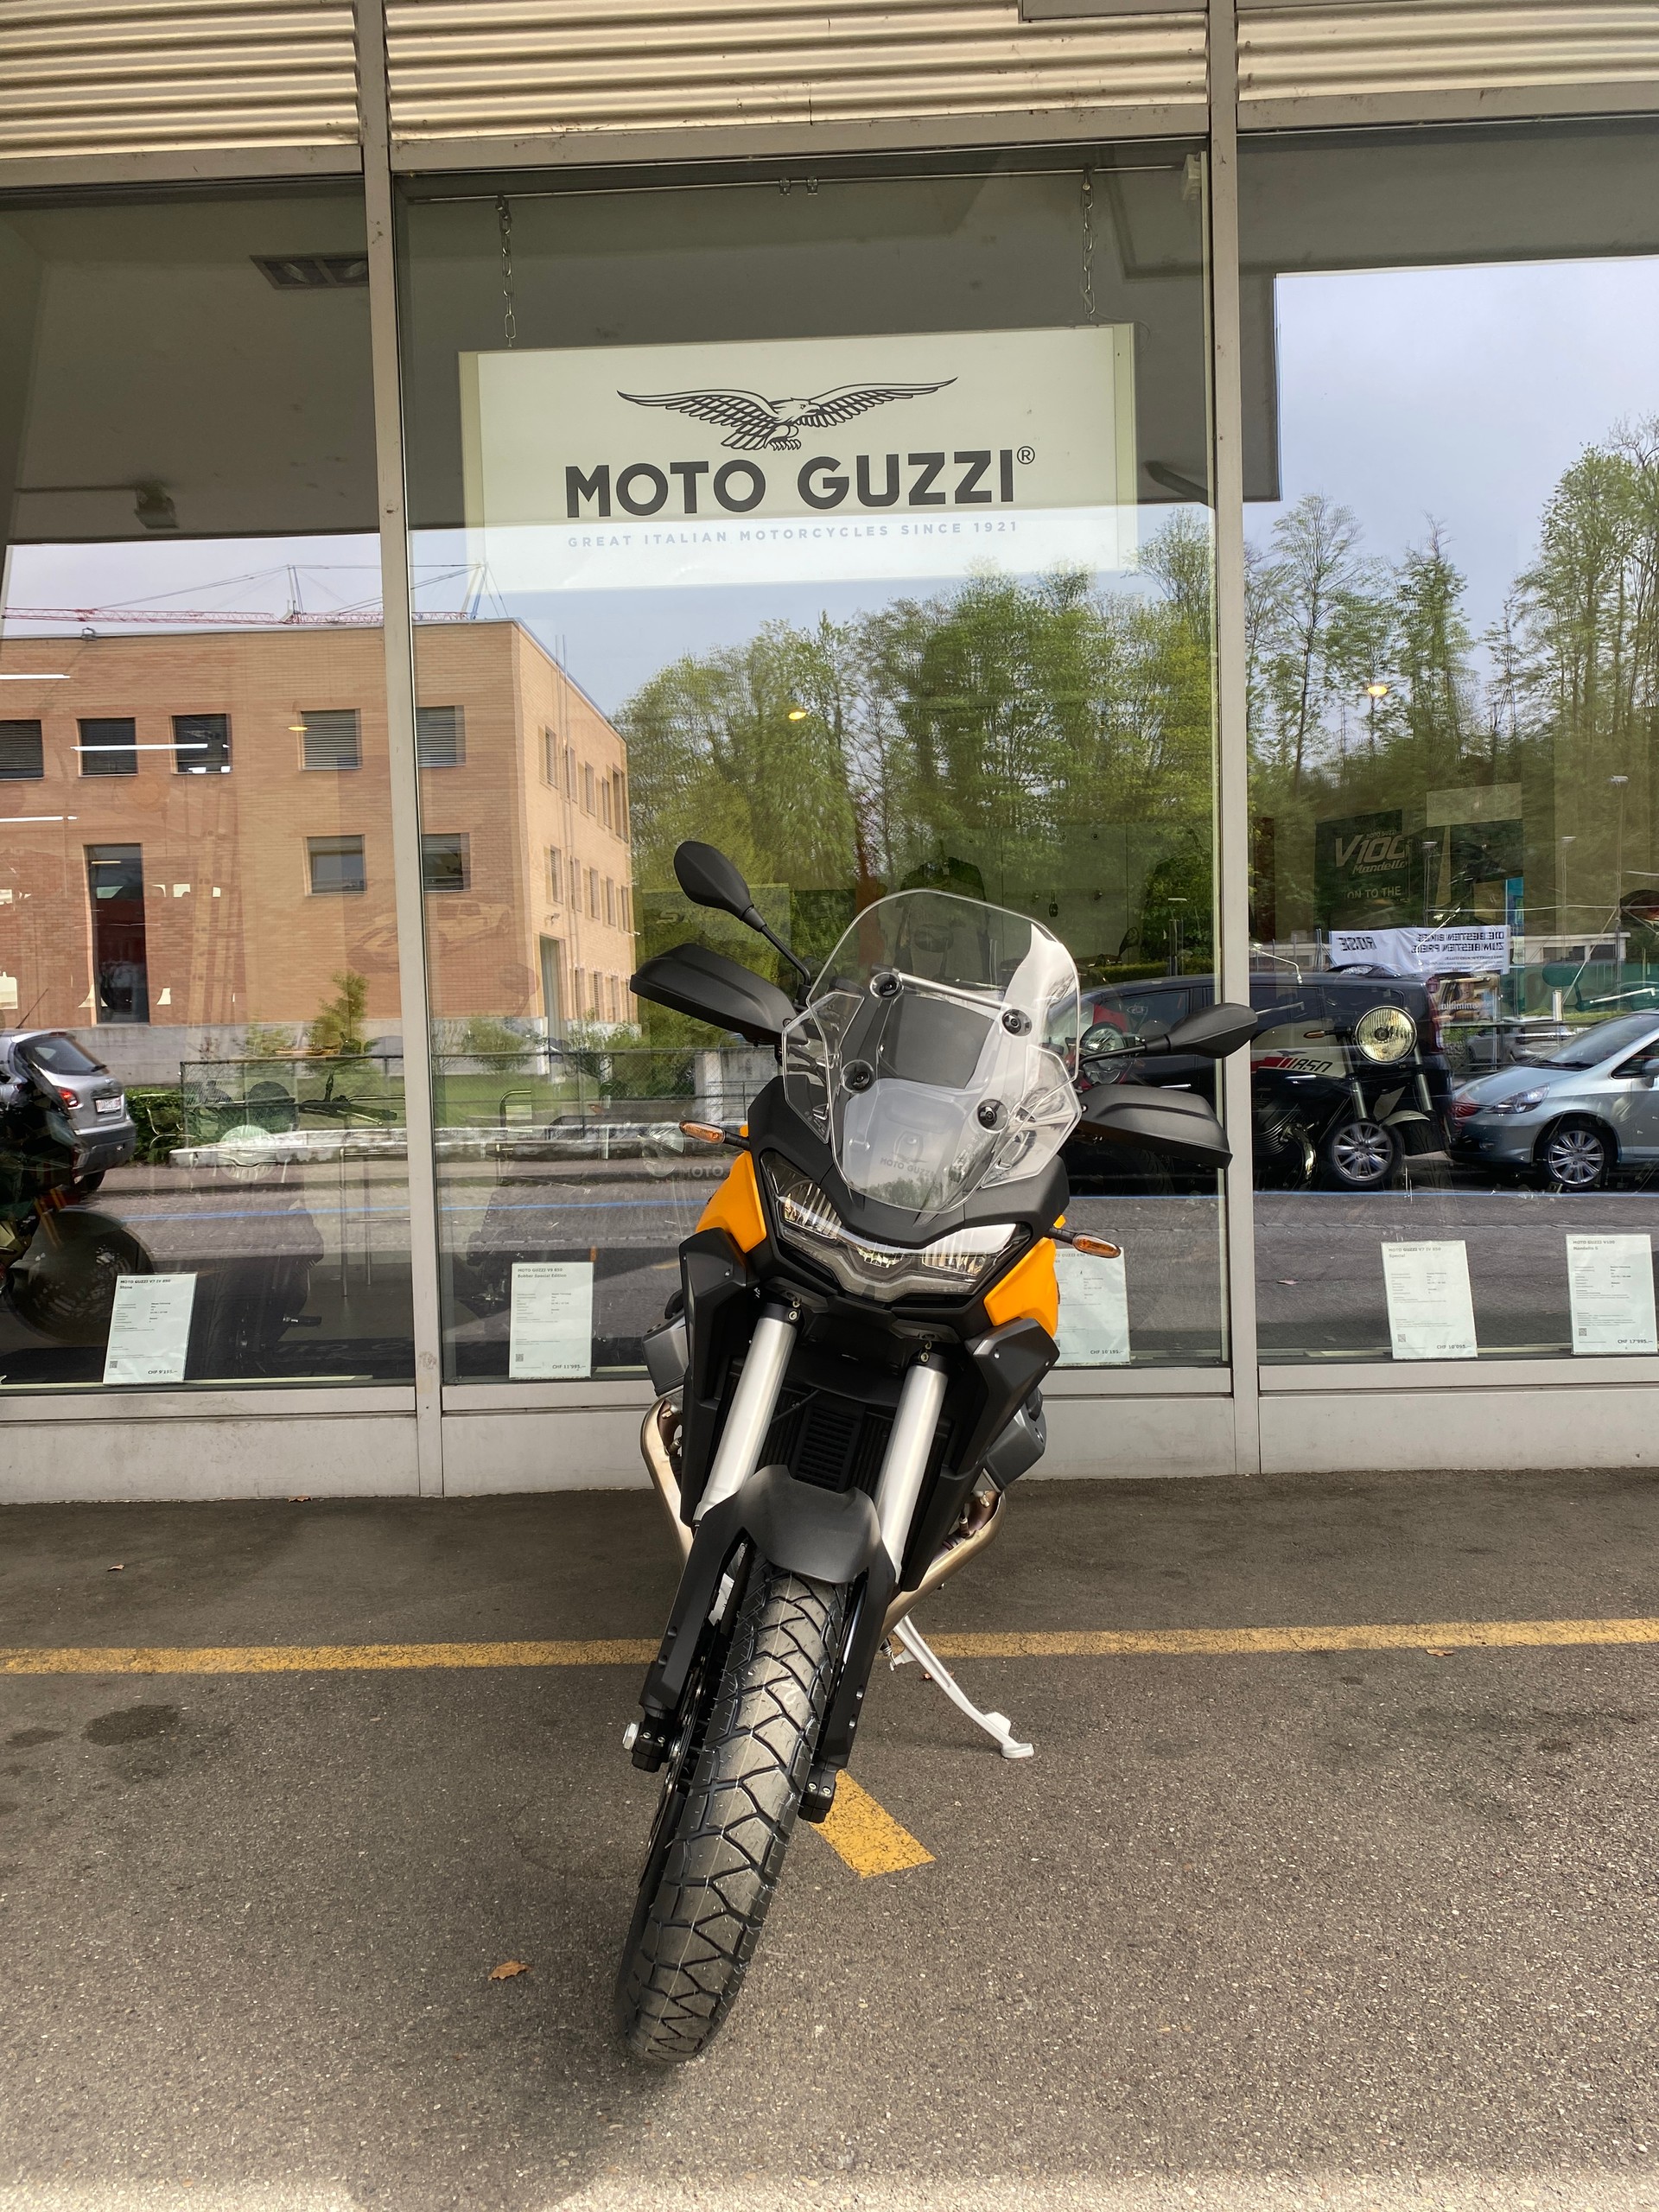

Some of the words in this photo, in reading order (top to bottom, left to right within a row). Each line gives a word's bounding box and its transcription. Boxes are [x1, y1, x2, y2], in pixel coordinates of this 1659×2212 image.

[566, 460, 766, 518] MOTO
[568, 536, 632, 548] GREAT
[644, 531, 728, 544] ITALIAN
[739, 525, 889, 542] MOTORCYCLES
[900, 523, 963, 536] SINCE
[973, 520, 1018, 533] 1921
[1364, 888, 1379, 898] TO
[1382, 886, 1402, 896] THE
